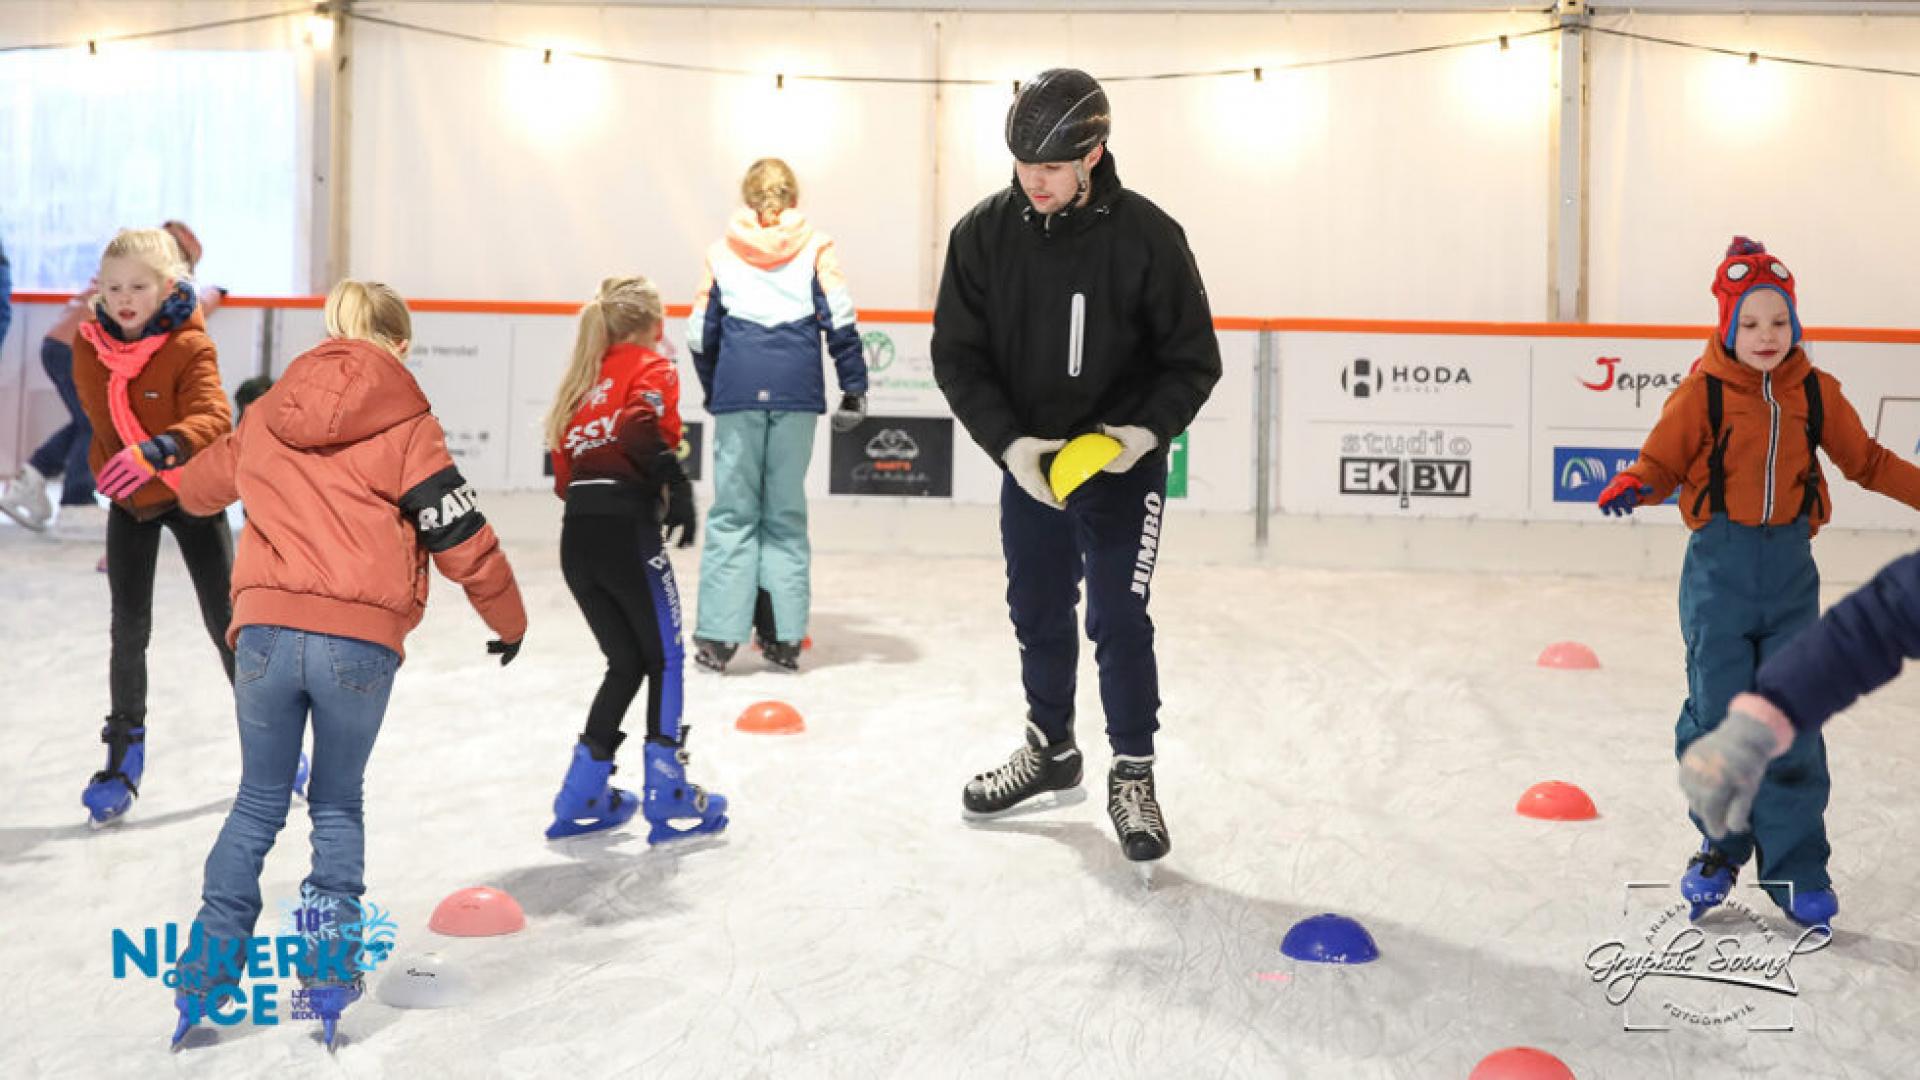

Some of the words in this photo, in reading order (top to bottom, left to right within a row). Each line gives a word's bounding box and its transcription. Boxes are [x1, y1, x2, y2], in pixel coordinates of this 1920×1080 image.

[1392, 366, 1472, 384] HODA
[1341, 430, 1472, 456] studio
[1343, 459, 1399, 493] EK
[1412, 462, 1467, 494] BV
[1130, 491, 1162, 600] JUMBO
